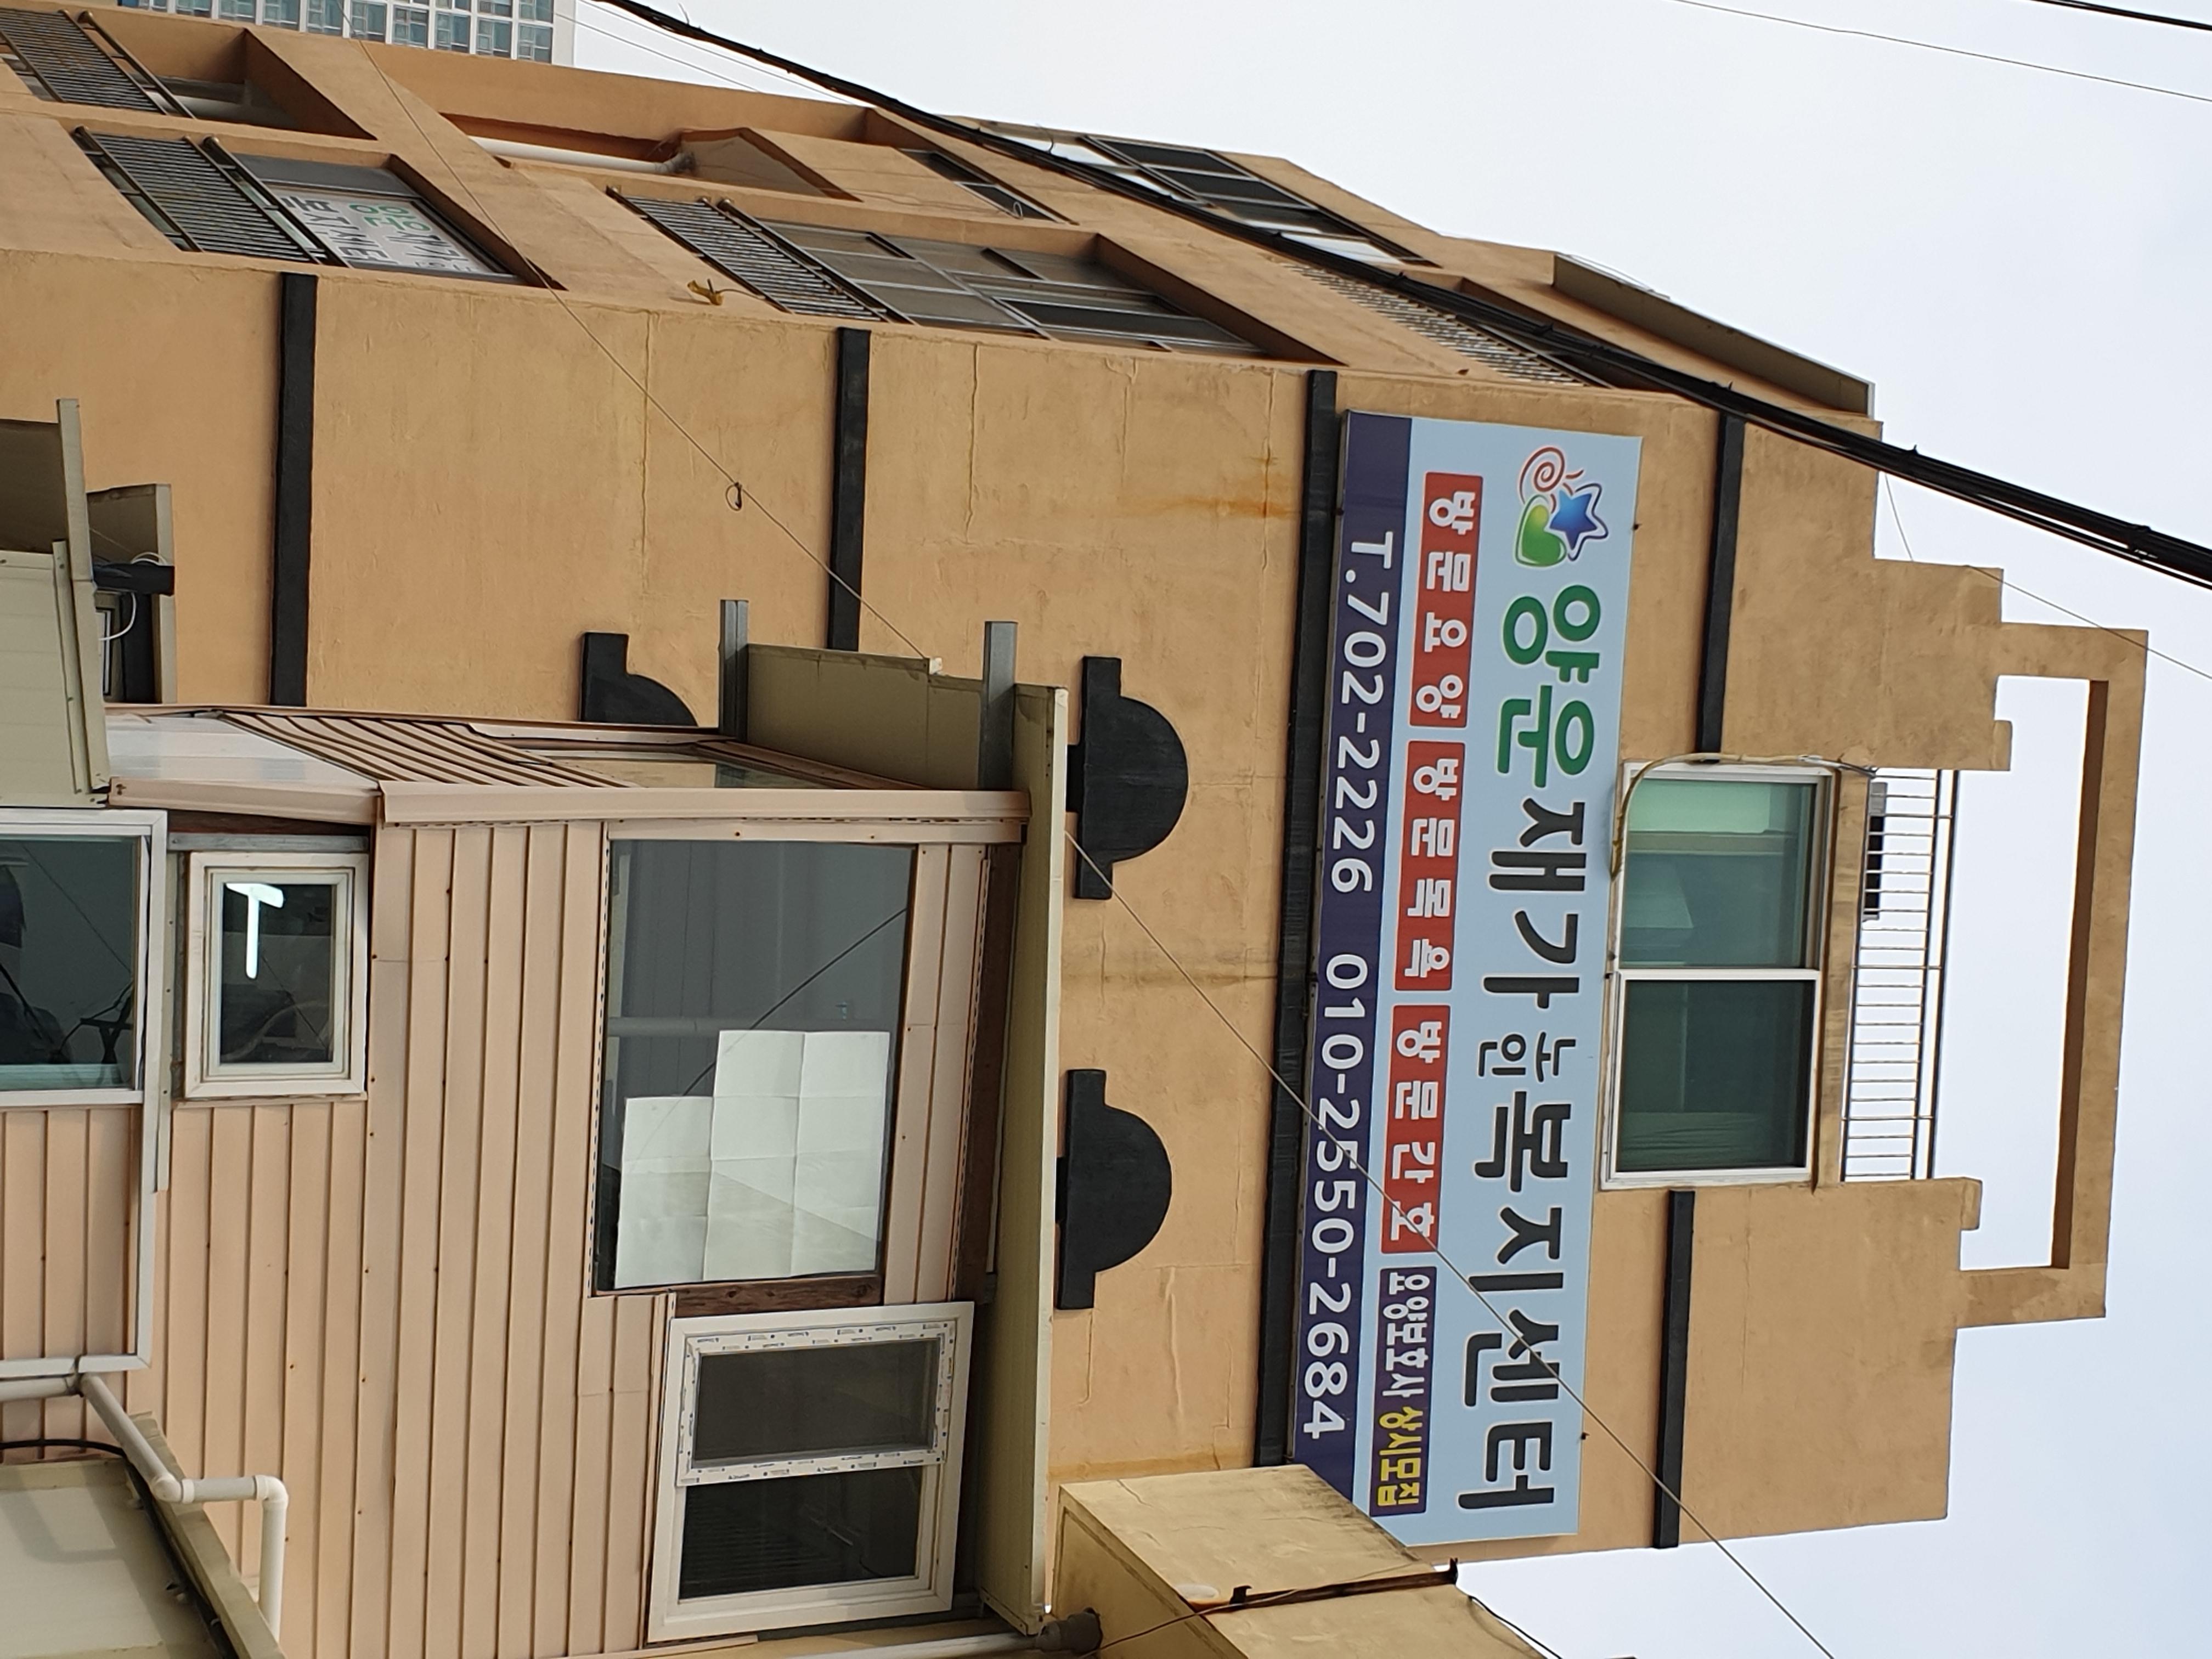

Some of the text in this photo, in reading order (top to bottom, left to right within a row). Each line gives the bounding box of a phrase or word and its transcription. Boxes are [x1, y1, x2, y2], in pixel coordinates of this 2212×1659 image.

[1304, 531, 1393, 1440] T.702-2226 010-2550-2684
[1390, 491, 1475, 1241] 방문요양 방문목욕 방문간호
[1377, 1272, 1430, 1505] 요양보호사 상시모집
